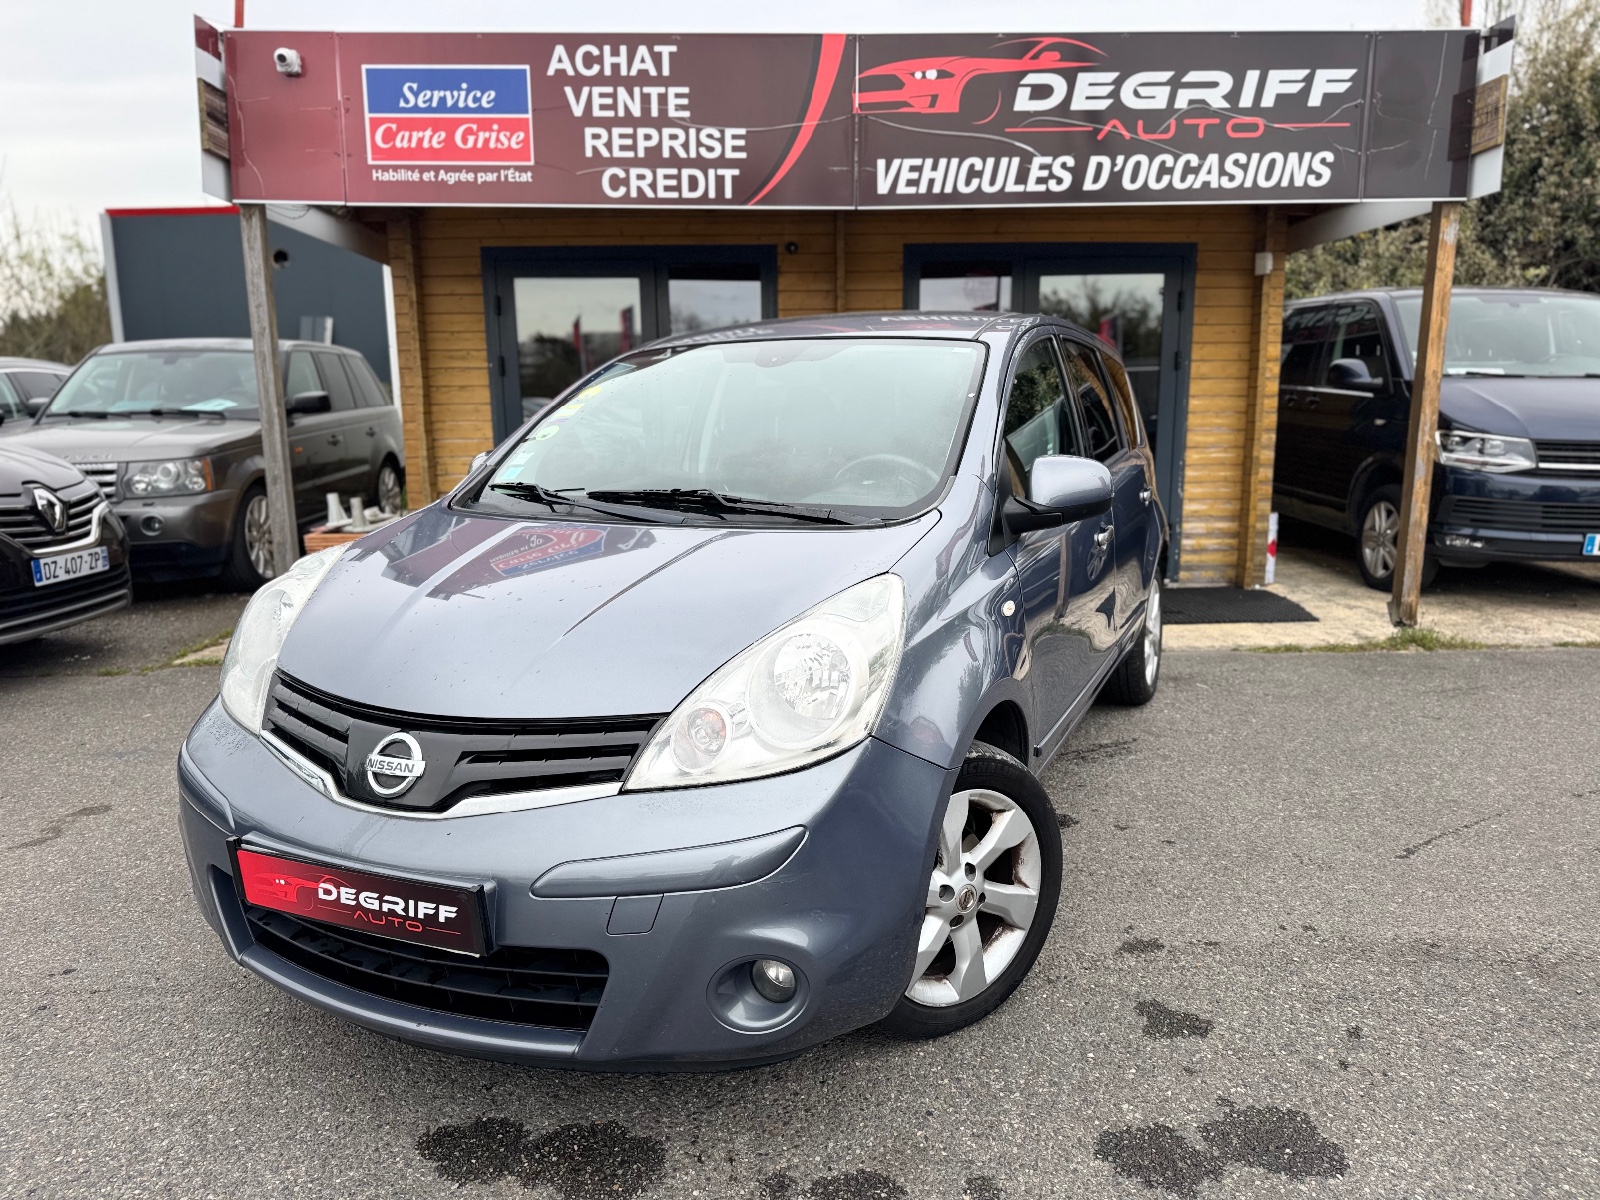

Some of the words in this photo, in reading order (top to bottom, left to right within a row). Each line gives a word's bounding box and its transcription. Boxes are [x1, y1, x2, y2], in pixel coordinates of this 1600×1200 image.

[546, 44, 678, 77] ACHAT
[399, 82, 496, 108] Service
[564, 86, 691, 117] VENTE
[1013, 69, 1358, 111] DEGRIFF
[374, 123, 446, 149] Carte
[454, 123, 525, 149] Grise
[584, 127, 747, 159] REPRISE
[1097, 118, 1265, 141] AUTO
[372, 169, 419, 181] Habilité
[422, 171, 435, 182] et
[438, 169, 475, 184] Agrée
[477, 172, 498, 184] par
[500, 168, 533, 182] l'État
[601, 167, 740, 199] CREDIT
[876, 155, 1075, 194] VEHICULES
[1083, 151, 1335, 191] D'OCCASIONS
[43, 552, 100, 580] DZ-407-ZP
[367, 758, 415, 773] NISSAN
[318, 883, 459, 922] DEGRIFF
[354, 911, 422, 932] AUTO
